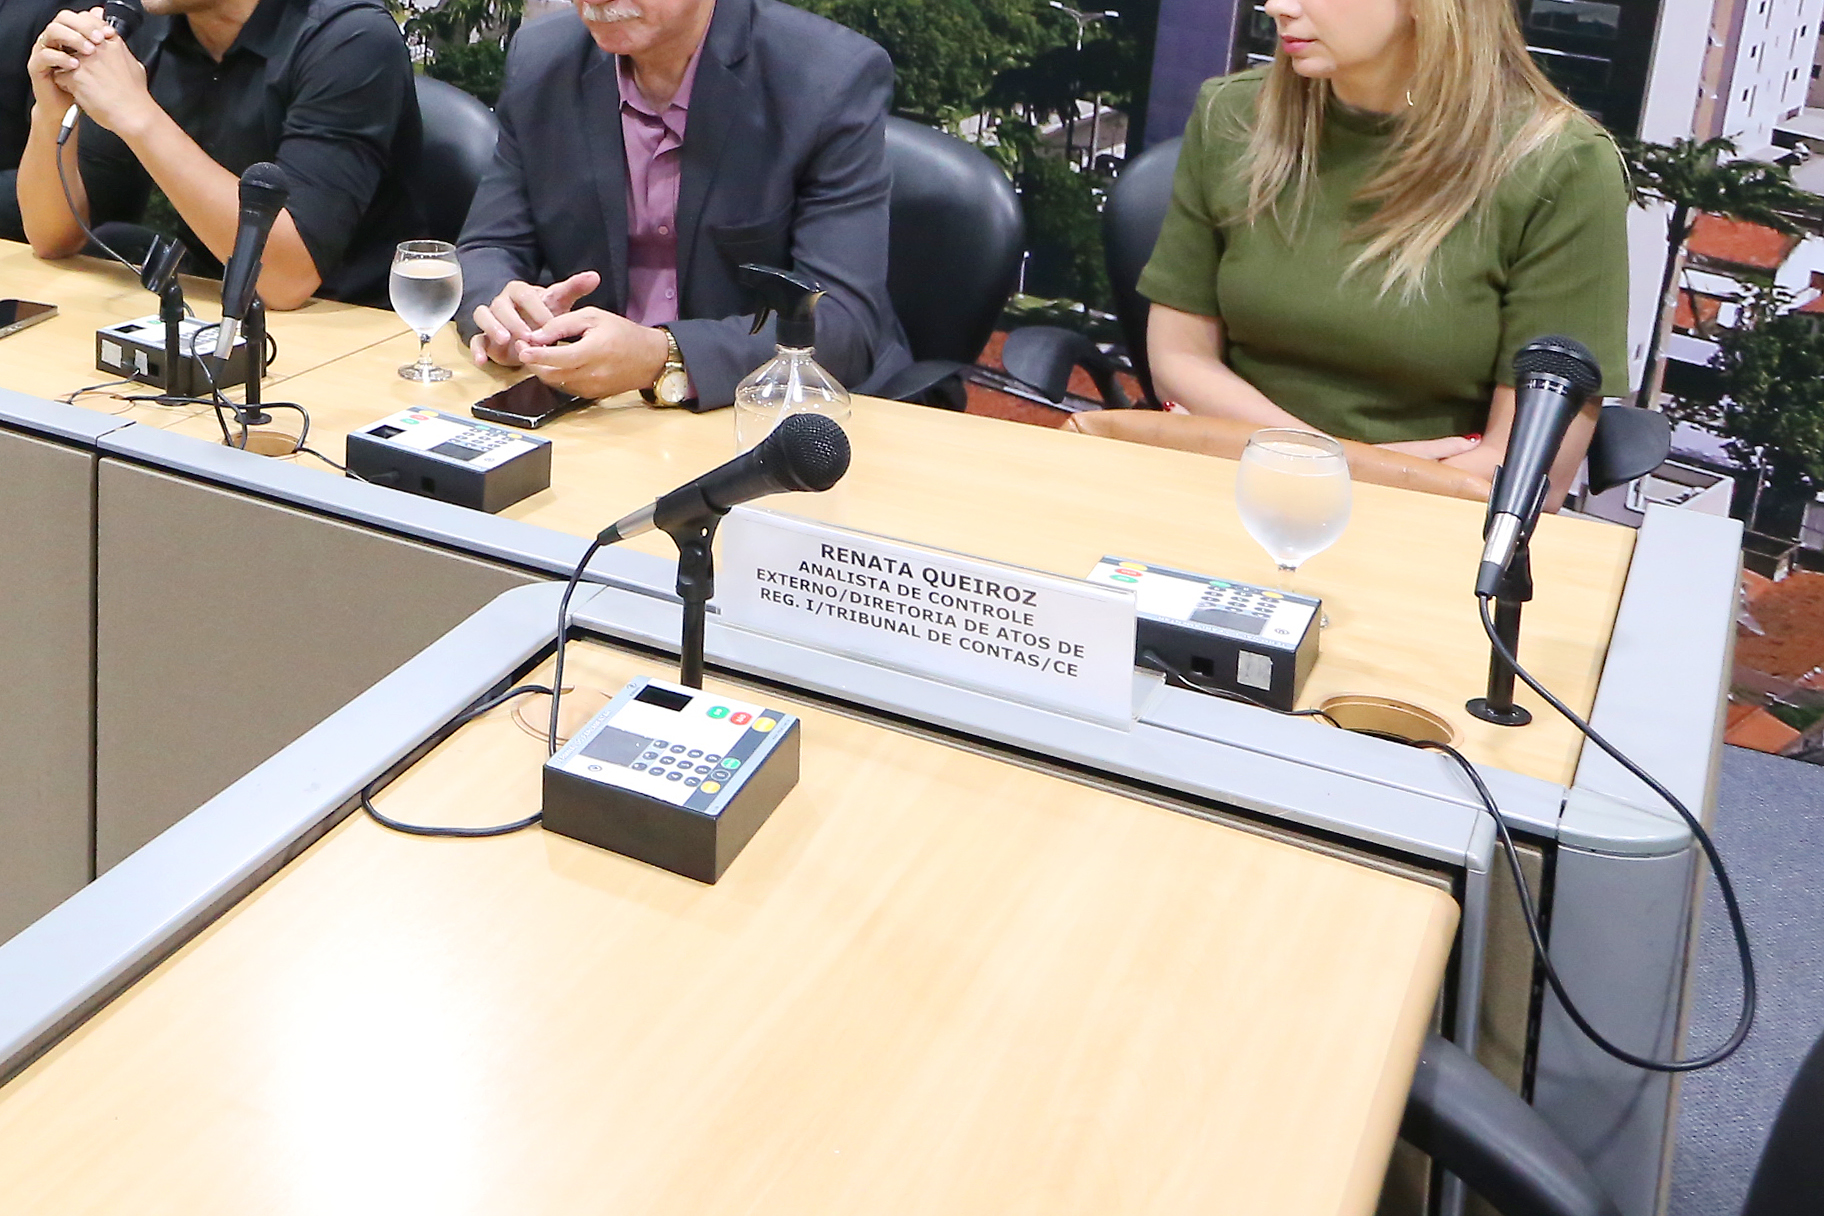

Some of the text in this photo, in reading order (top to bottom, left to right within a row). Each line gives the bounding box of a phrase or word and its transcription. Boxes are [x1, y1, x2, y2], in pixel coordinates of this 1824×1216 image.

[756, 568, 1085, 659] EXTERNO/DIRETORIA DE ATOS DE
[798, 560, 1034, 627] ANALISTA DE CONTROLE
[821, 543, 1038, 607] RENATA QUEIROZ
[760, 587, 1078, 677] REG. I/TRIBUNAL DE CONTAS/CE
